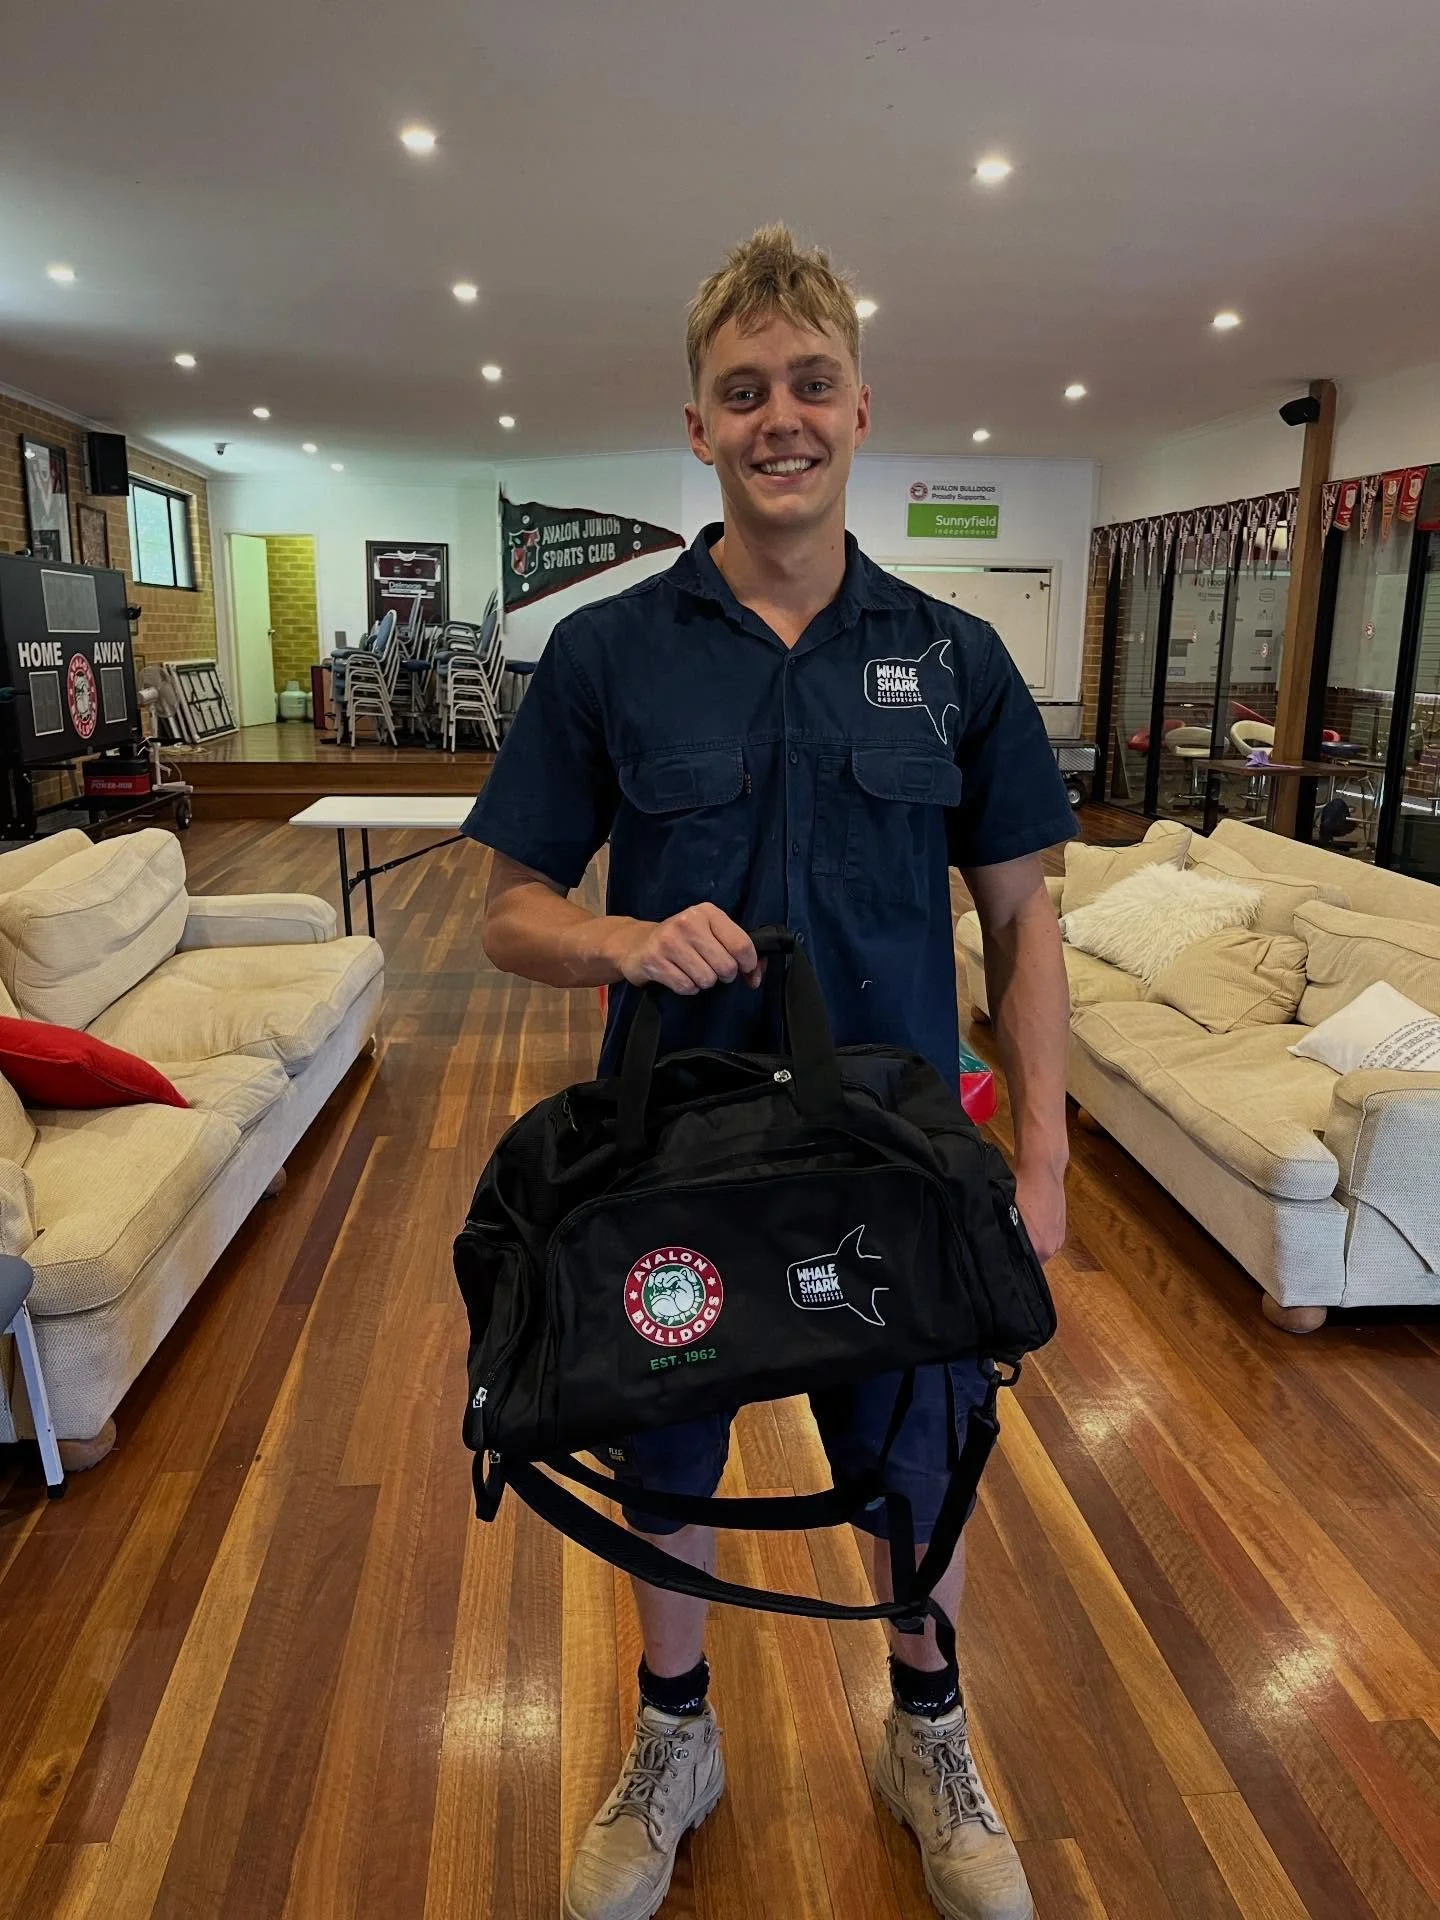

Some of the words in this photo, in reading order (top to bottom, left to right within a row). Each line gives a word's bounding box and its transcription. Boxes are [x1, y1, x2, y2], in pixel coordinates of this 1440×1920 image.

[931, 493, 956, 501] Proudly
[541, 520, 581, 546] AVALON
[582, 517, 621, 539] JUNIOR
[935, 515, 997, 528] Sunnyfield
[542, 548, 584, 570] SPORTS
[588, 542, 616, 564] CLUB
[17, 642, 64, 668] HOME
[93, 642, 125, 664] AWAY
[876, 664, 918, 680] WHALE
[877, 678, 919, 692] SHARK
[633, 1251, 708, 1282] AVALON
[796, 1263, 837, 1281] WHALE
[800, 1276, 841, 1294] SHARK
[631, 1295, 720, 1343] BULLDOGS
[649, 1355, 682, 1371] EST.
[684, 1348, 717, 1362] 1962
